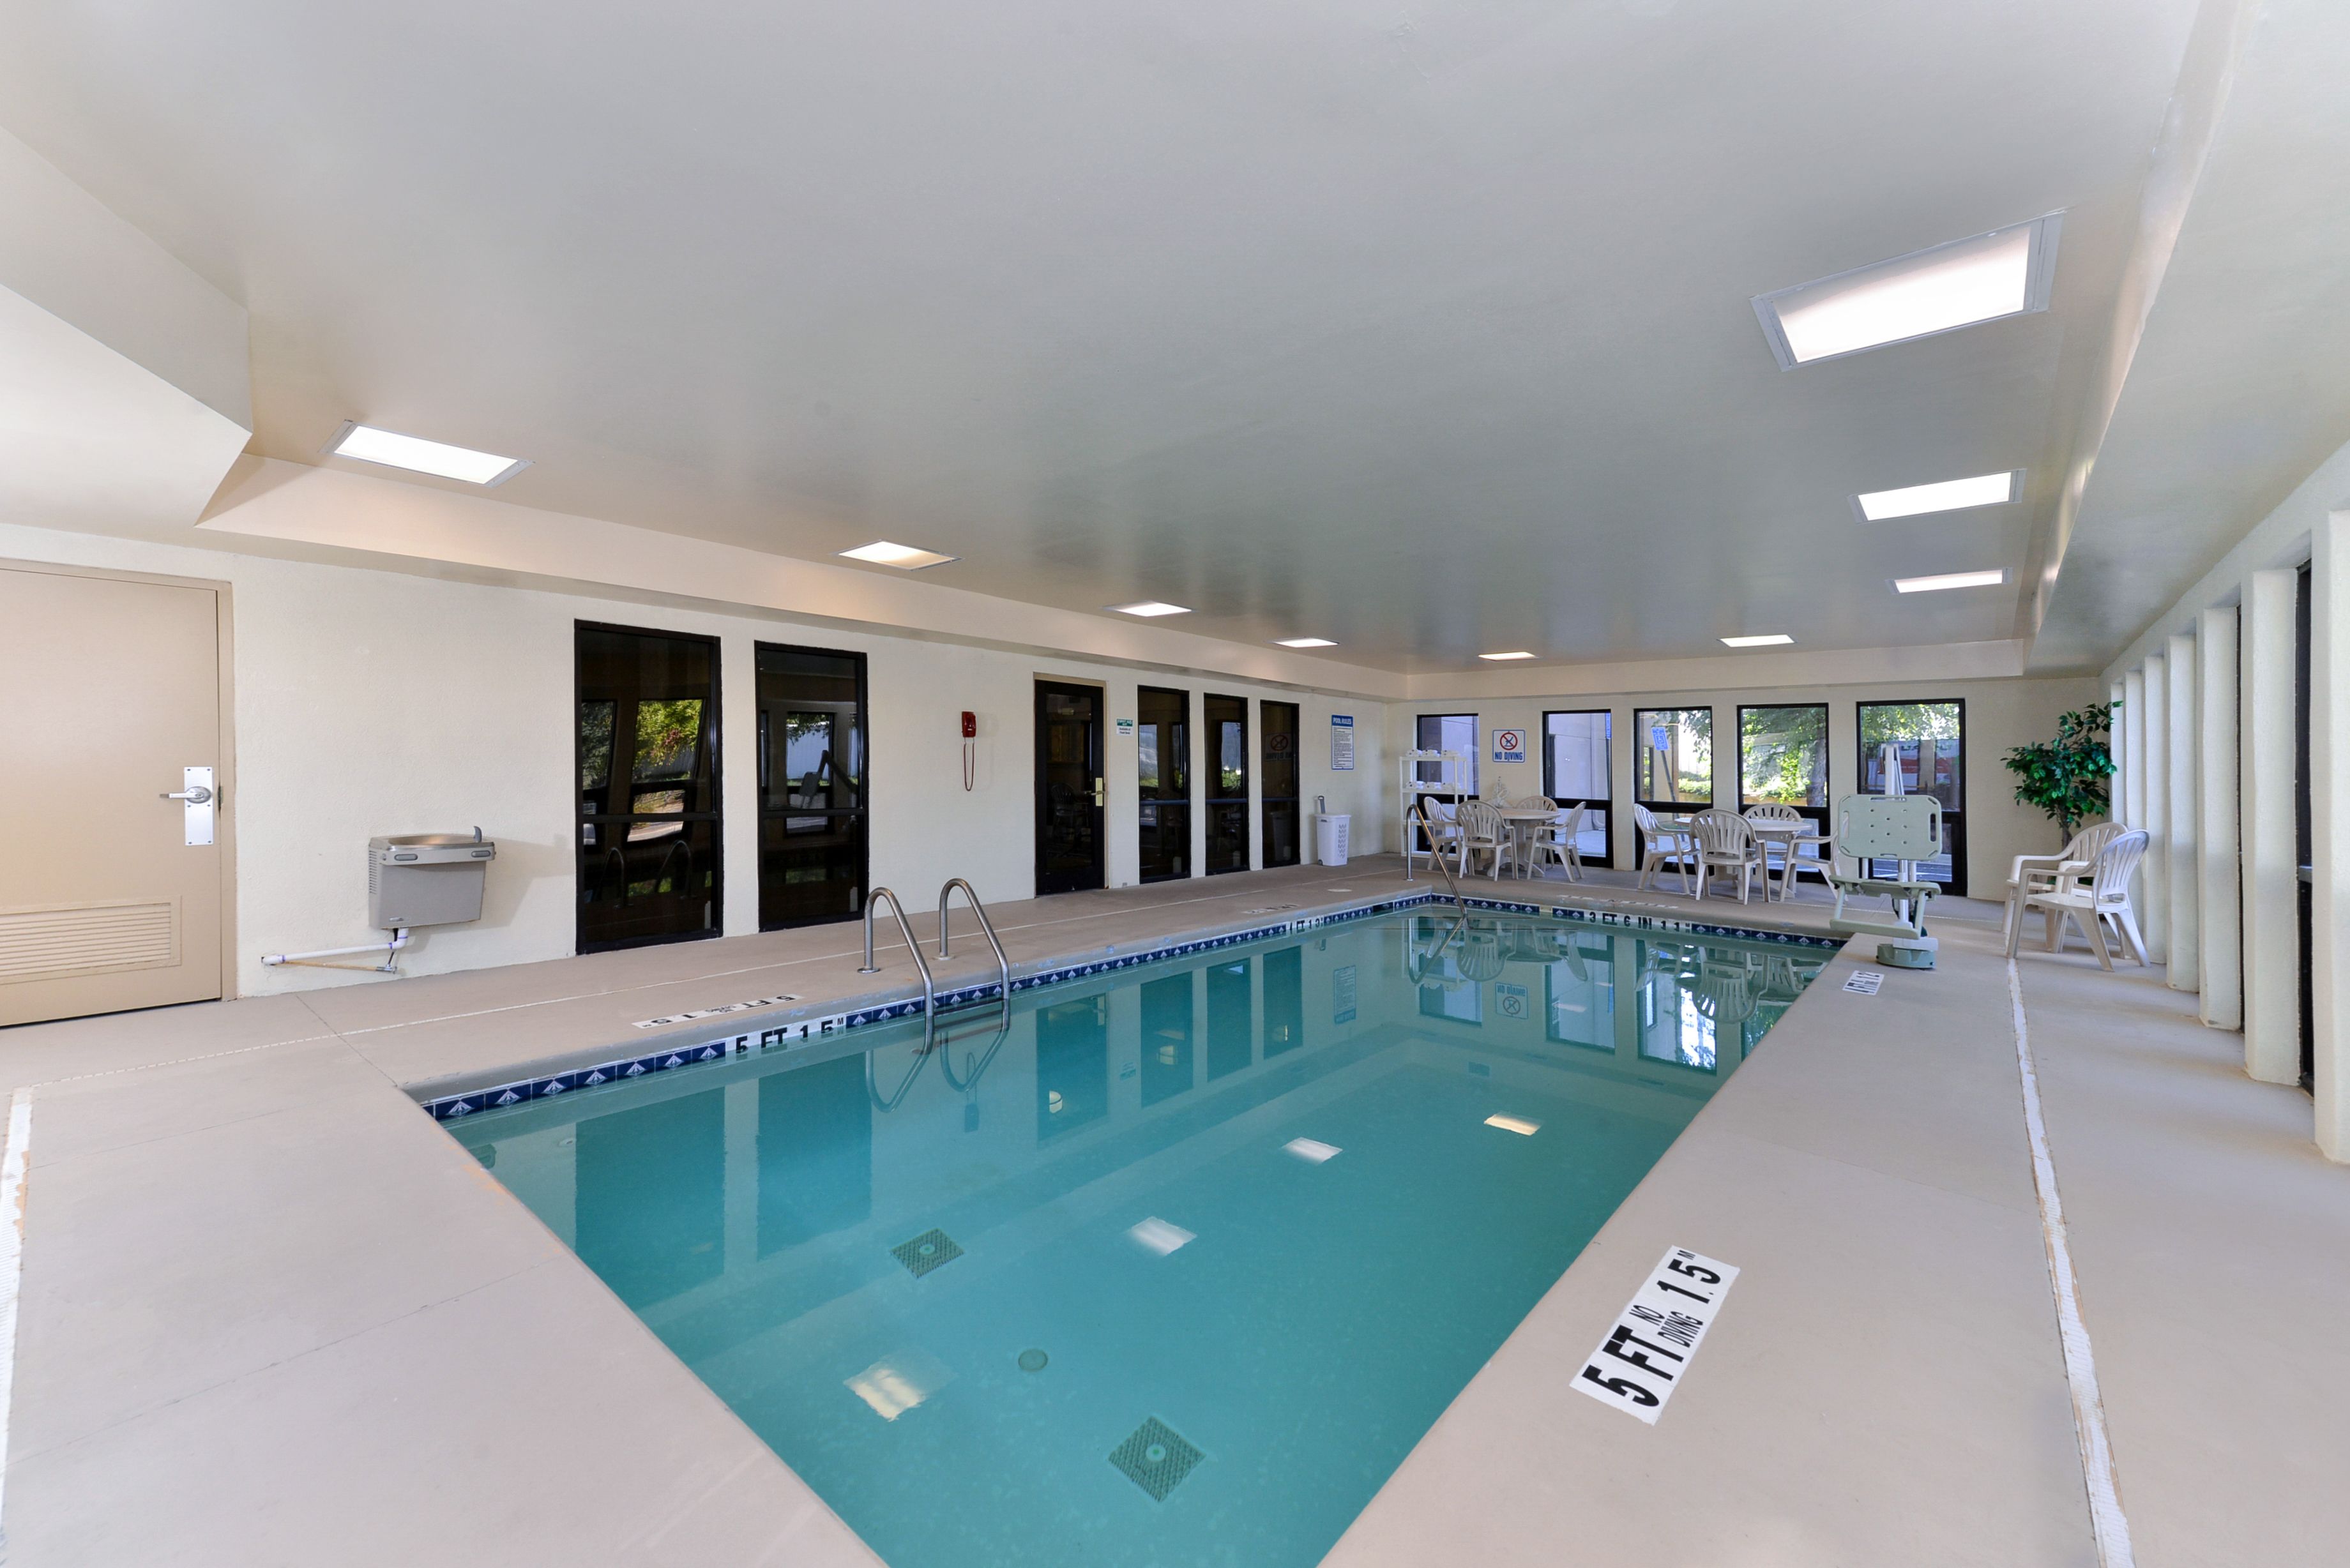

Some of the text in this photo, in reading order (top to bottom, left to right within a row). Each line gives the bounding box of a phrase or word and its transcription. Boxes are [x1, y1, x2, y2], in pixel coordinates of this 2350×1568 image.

[1505, 752, 1522, 760] DIVING
[742, 1000, 772, 1008] FT
[736, 1036, 749, 1053] 5
[761, 1027, 787, 1048] FT
[1628, 1304, 1665, 1326] NO
[1581, 1249, 1721, 1407] 5 FT 1.5 M
[1657, 1311, 1704, 1348] DIVING
